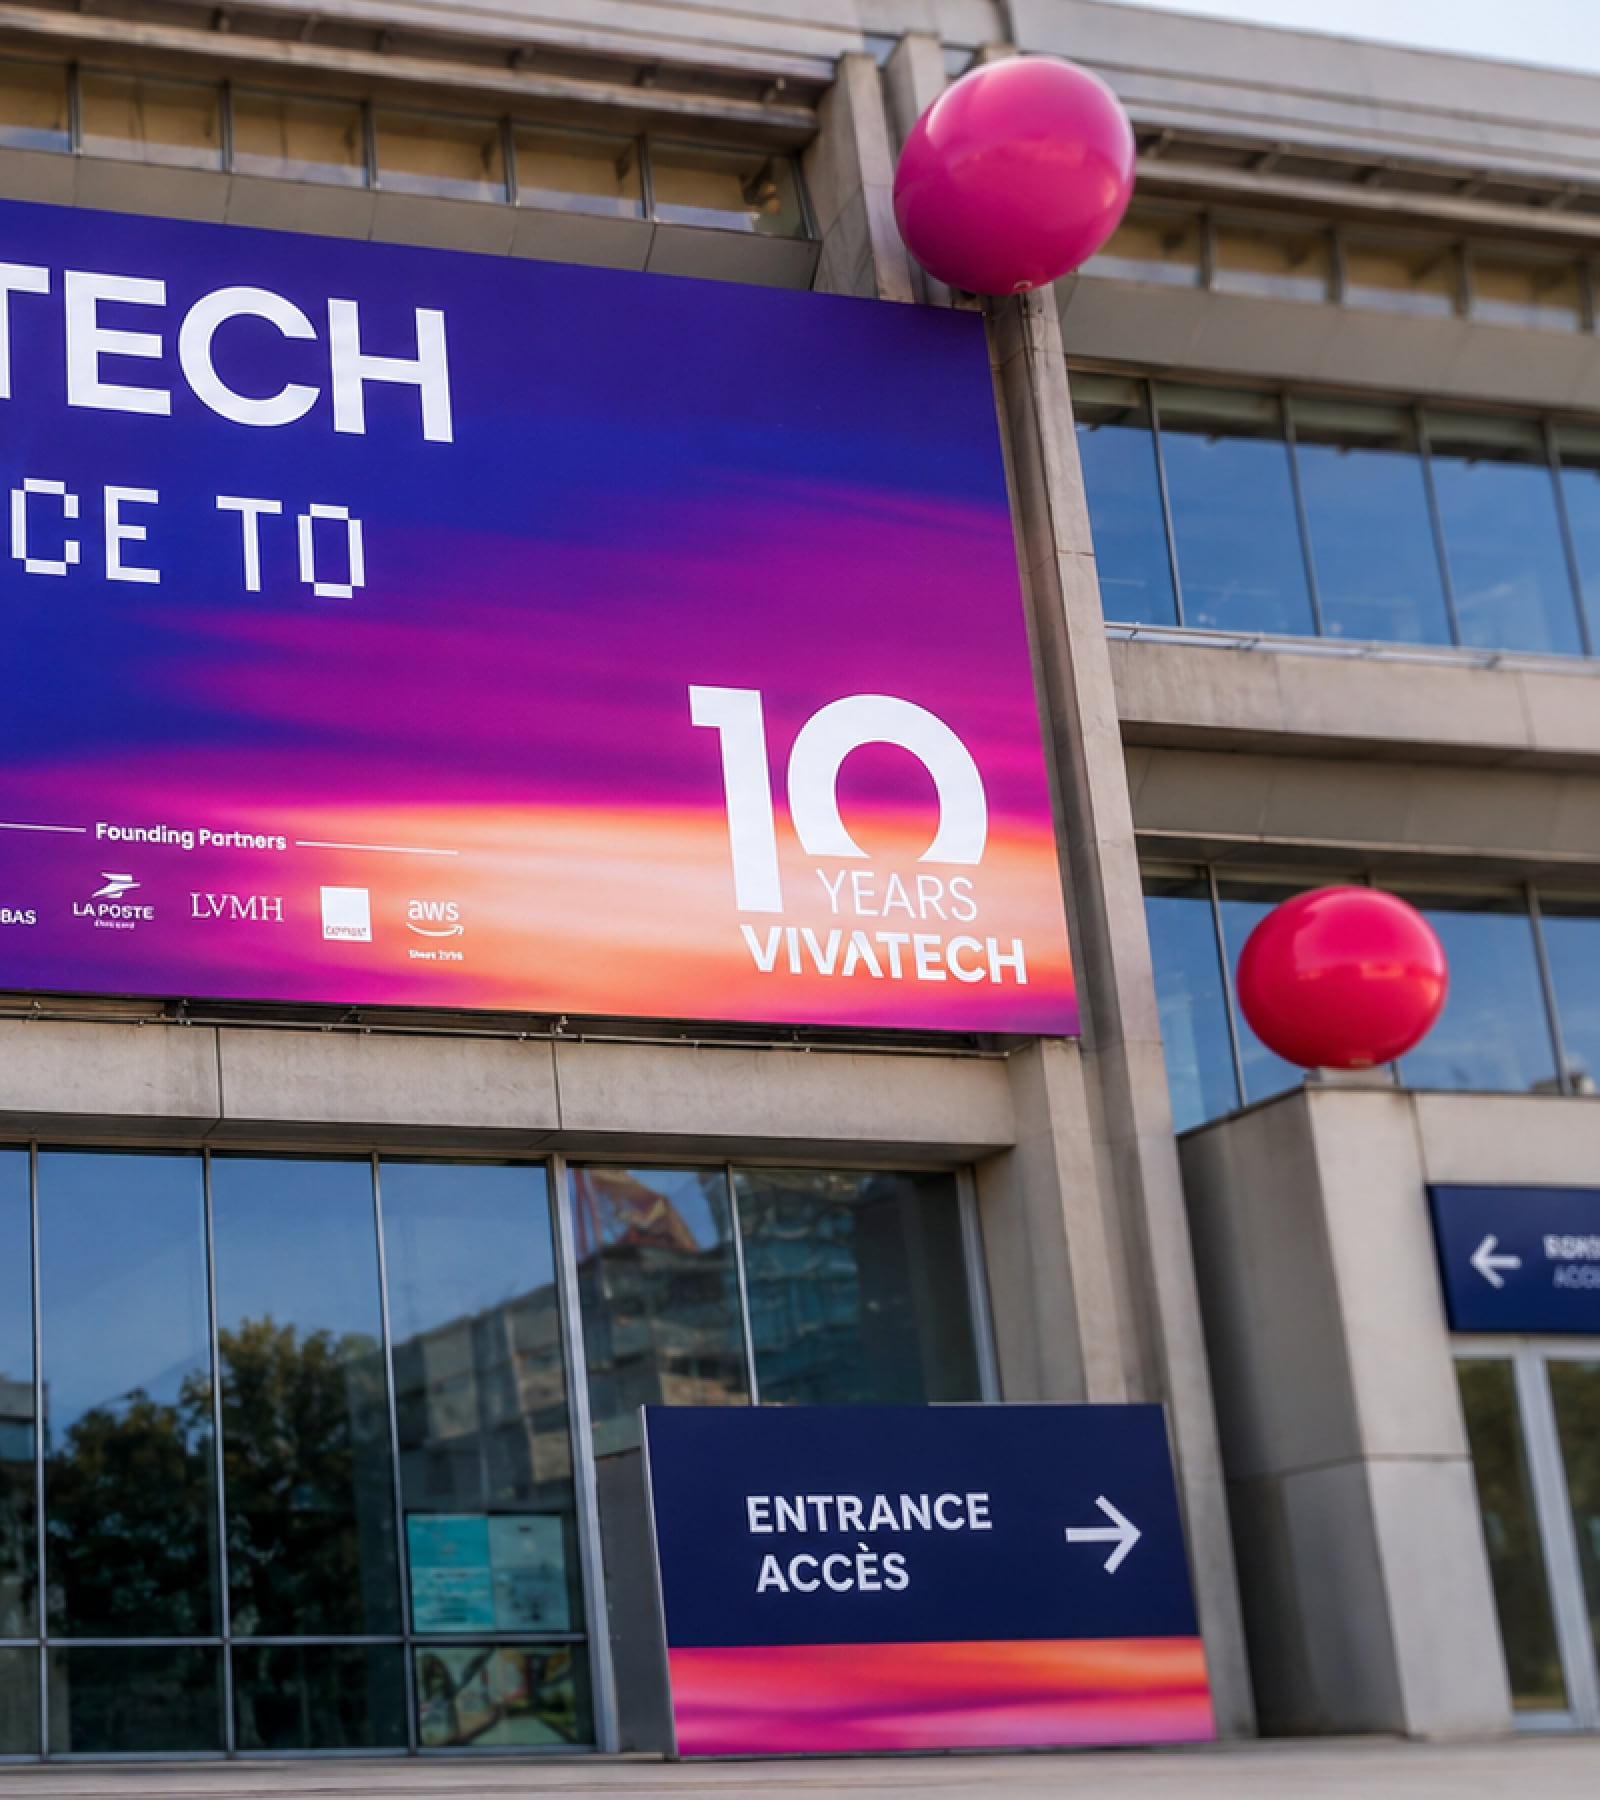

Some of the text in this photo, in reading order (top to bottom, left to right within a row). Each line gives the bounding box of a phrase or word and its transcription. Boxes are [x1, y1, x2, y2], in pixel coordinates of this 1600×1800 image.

[215, 495, 365, 599] TO
[688, 684, 988, 914] 10
[95, 821, 288, 850] Founding Partners
[73, 901, 155, 920] LA POSTE
[190, 892, 284, 922] LVMH
[407, 899, 460, 922] aws
[815, 867, 977, 922] YEARS
[740, 923, 1029, 985] VIVATECH
[746, 1492, 993, 1534] ENTRANCE
[756, 1541, 911, 1593] ACCÈS
